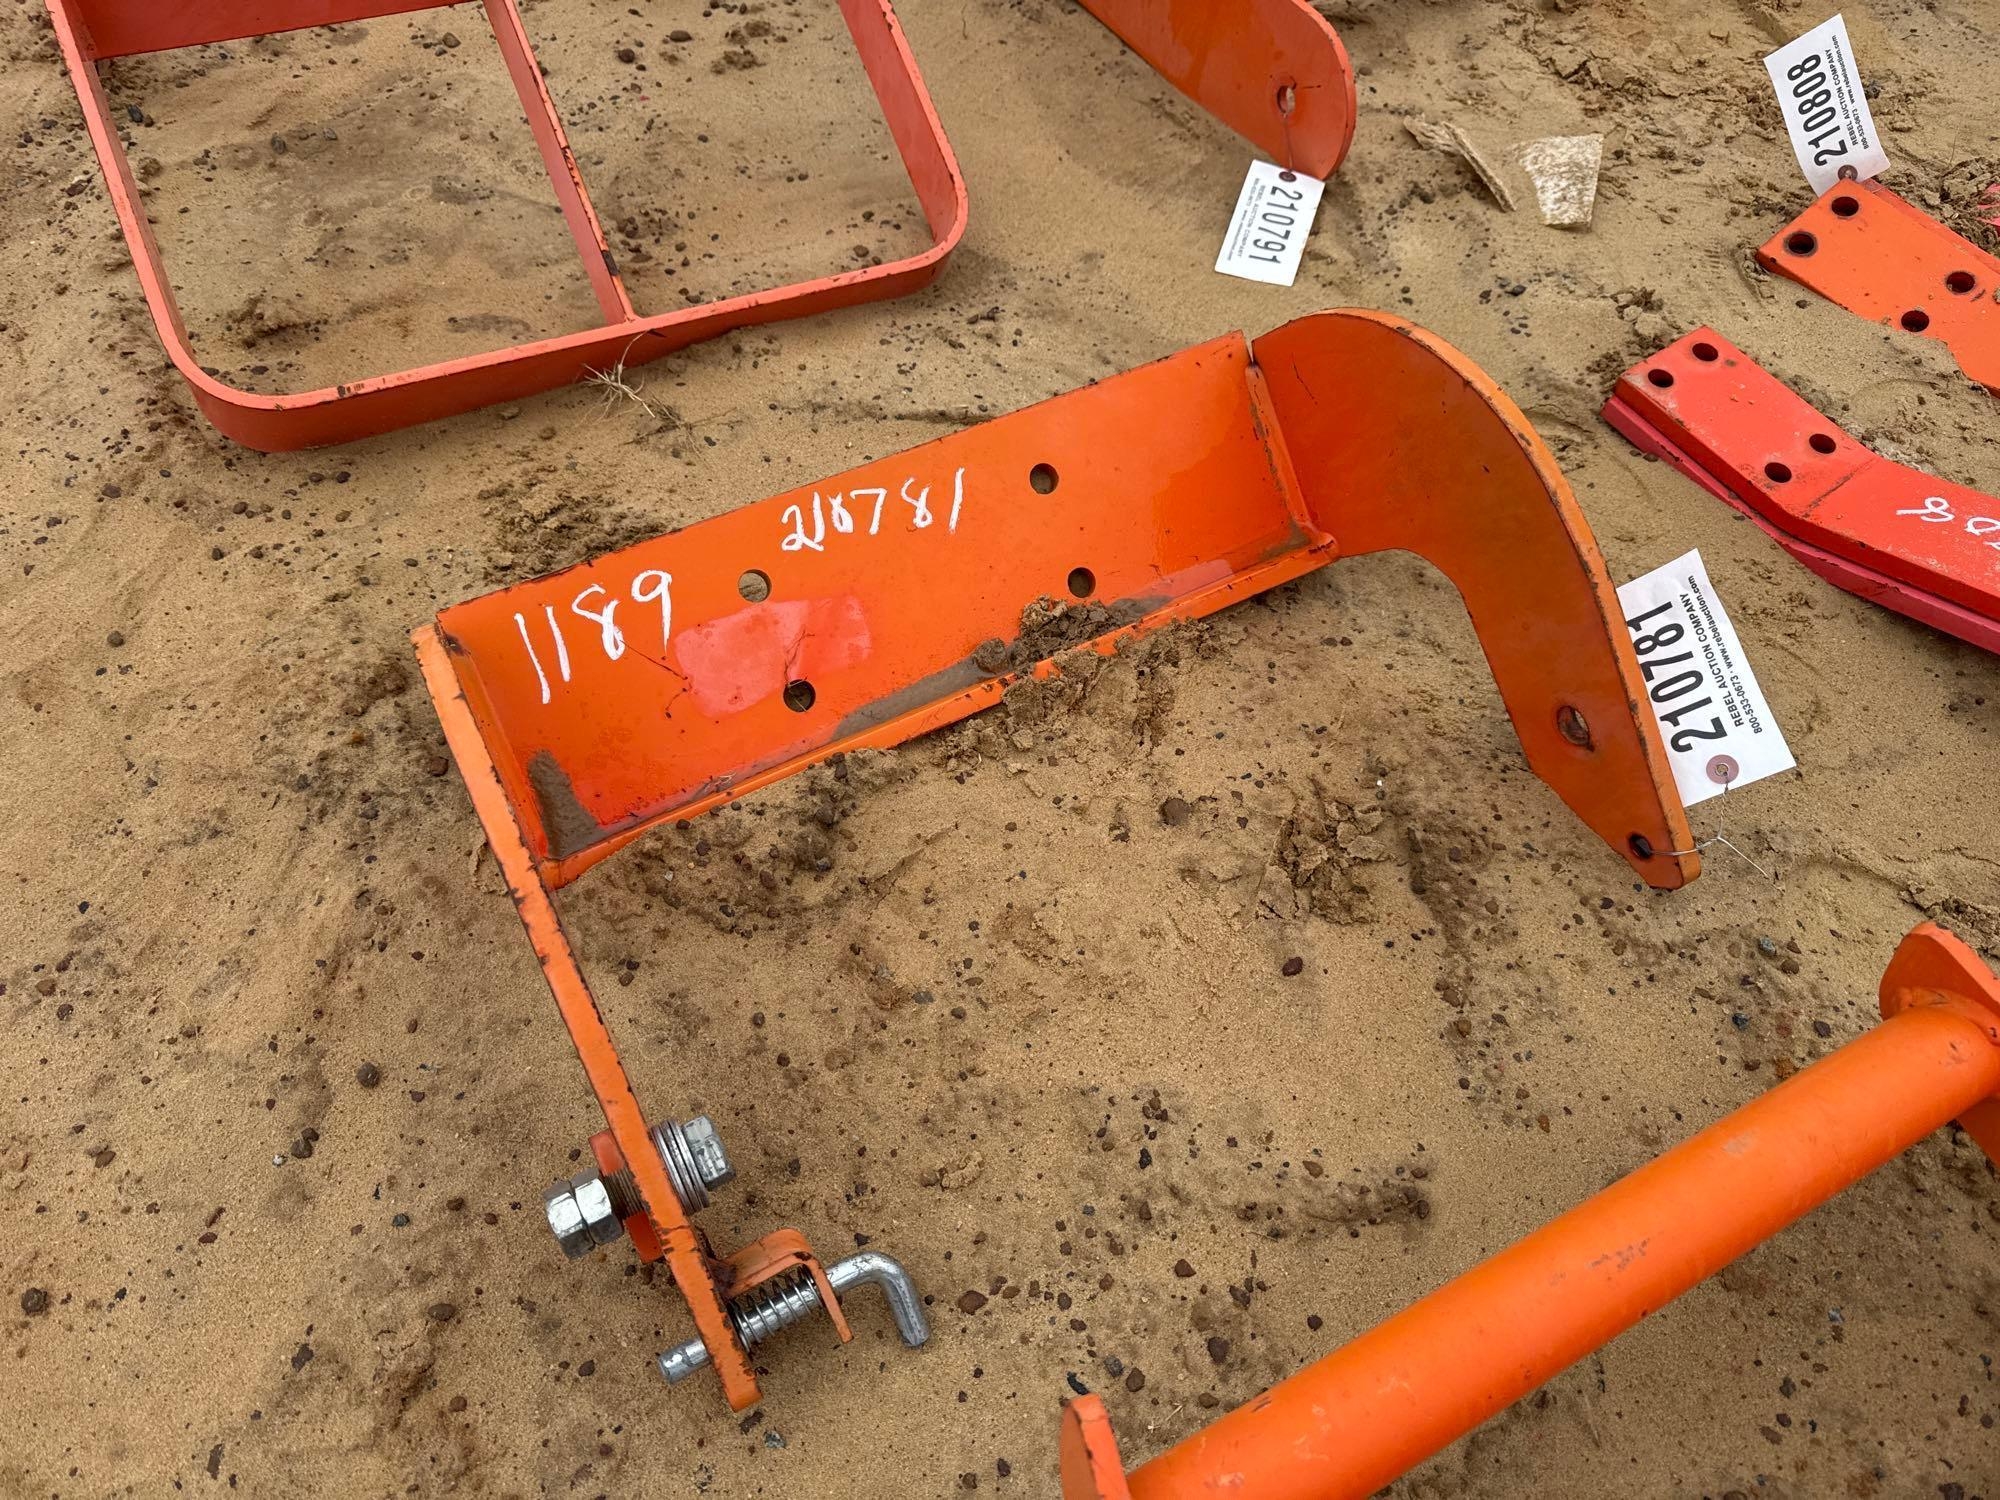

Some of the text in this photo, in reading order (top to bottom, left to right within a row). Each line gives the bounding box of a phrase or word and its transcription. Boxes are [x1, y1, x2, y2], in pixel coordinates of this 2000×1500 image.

[1787, 54, 1848, 166] 210808
[1825, 49, 1859, 146] REBEL AUCTION COMPANY
[1831, 35, 1855, 105] www.rebelauction.com
[1248, 186, 1303, 264] 210791
[513, 569, 673, 704] 1189
[1626, 601, 1728, 753] 210781
[1680, 593, 1744, 727] REBEL AUCTION COMPANY
[1688, 575, 1763, 734] 800-533-0673 www.rebelauction.com
